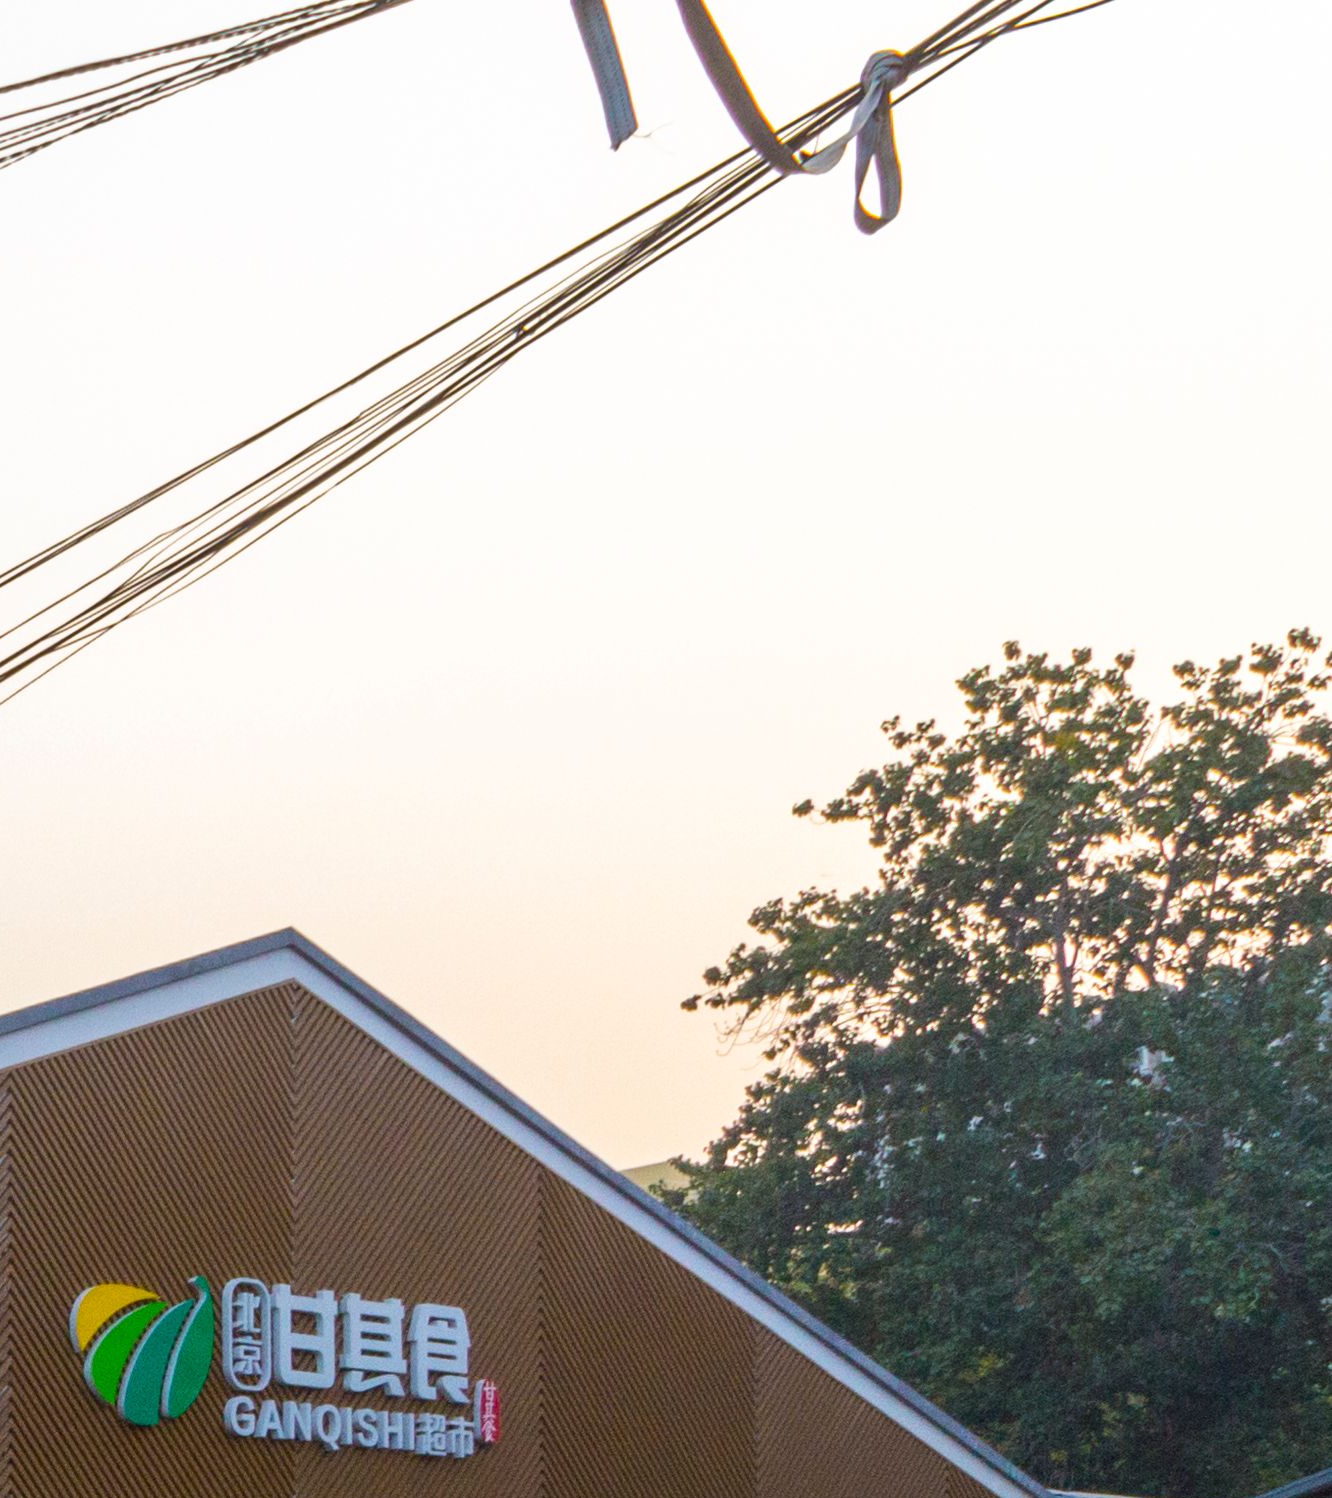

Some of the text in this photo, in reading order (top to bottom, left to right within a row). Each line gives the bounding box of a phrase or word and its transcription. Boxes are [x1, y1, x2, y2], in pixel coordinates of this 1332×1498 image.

[232, 1283, 471, 1404] 北京 甘其食
